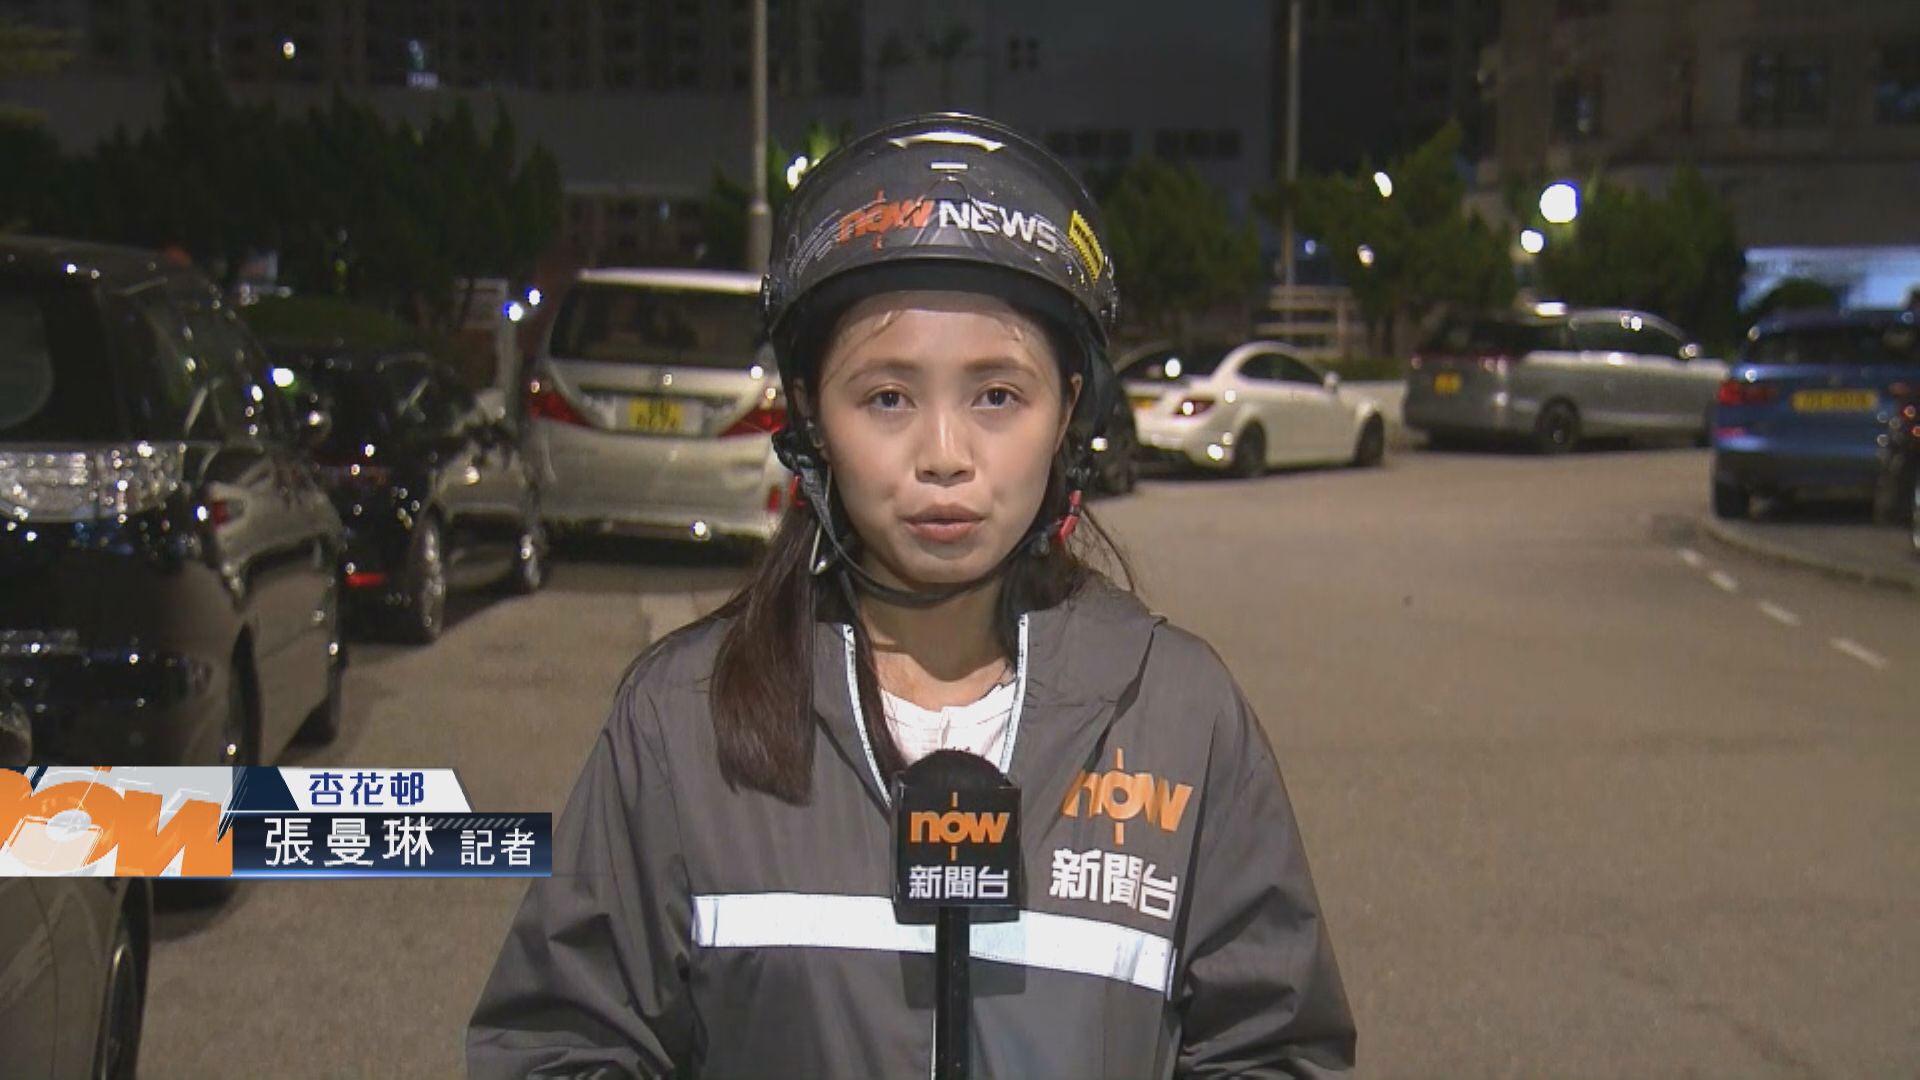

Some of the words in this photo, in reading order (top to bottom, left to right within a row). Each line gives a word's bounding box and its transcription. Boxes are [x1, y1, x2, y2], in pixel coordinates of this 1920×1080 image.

[838, 195, 935, 246] now
[938, 198, 1059, 254] NEWS
[1062, 768, 1193, 832] now
[909, 865, 1010, 900] 新聞台
[1049, 848, 1178, 920] 新聞台
